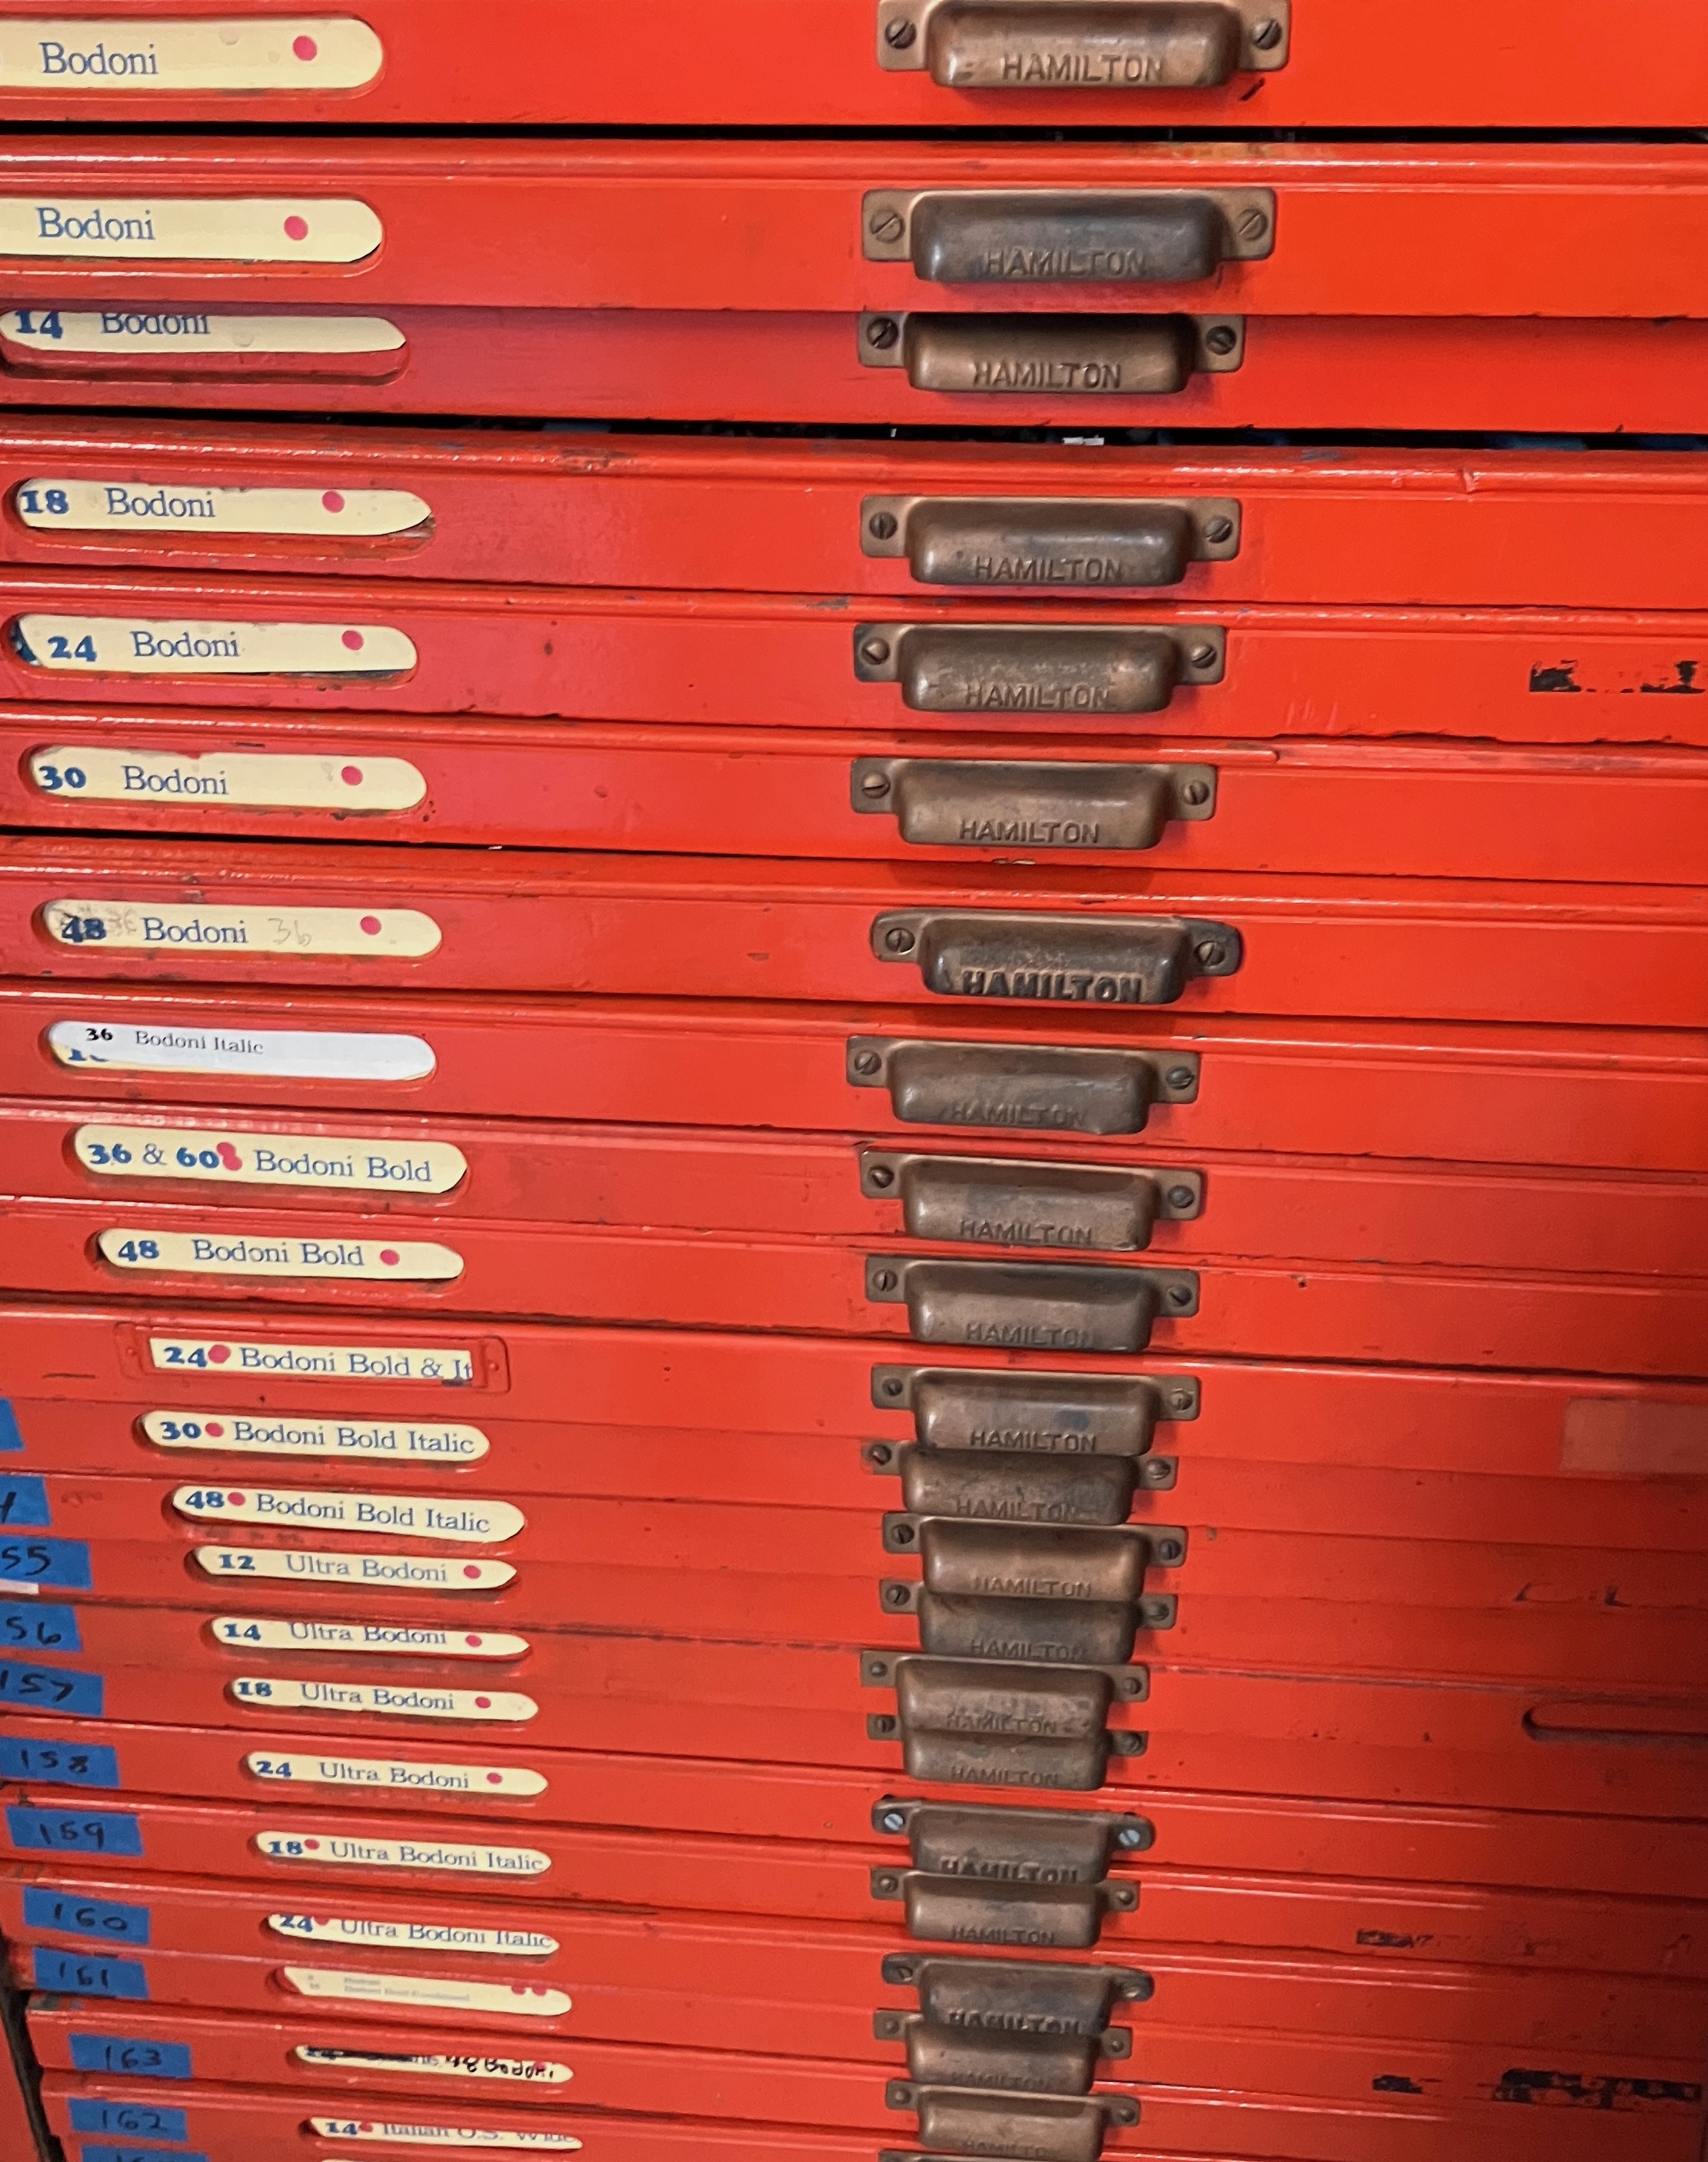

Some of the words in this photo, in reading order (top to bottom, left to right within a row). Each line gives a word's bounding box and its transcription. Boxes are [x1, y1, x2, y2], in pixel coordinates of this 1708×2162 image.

[39, 42, 158, 75] Bodoni
[1000, 54, 1163, 82] HAMILTON
[36, 207, 156, 240] Bodoni
[982, 248, 1147, 276] HAMILTON
[15, 311, 63, 339] 14
[972, 361, 1121, 388] HAMILTON
[22, 490, 70, 514] 18
[105, 488, 215, 518] Bodoni
[974, 556, 1124, 582] HAMILTON
[47, 636, 97, 662] 24
[130, 631, 240, 658] Bodoni
[963, 683, 1110, 709] HAMILTON
[38, 767, 87, 791] 30
[123, 765, 228, 795] Bodoni
[959, 820, 1100, 844] HAMILTON
[60, 915, 107, 943] 48
[142, 916, 248, 944] Bodoni
[962, 971, 1141, 1001] HAMILTON
[85, 1028, 113, 1041] 36
[136, 1031, 205, 1049] Bodoni
[215, 1036, 264, 1054] Italic
[952, 1101, 1086, 1128] HAMILTON
[87, 1143, 132, 1164] 36
[142, 1144, 167, 1165] &
[177, 1147, 219, 1168] 60
[255, 1150, 354, 1177] Bodoni
[367, 1155, 433, 1182] Bold
[961, 1219, 1092, 1245] HAMILTON
[118, 1240, 160, 1262] 48
[193, 1239, 288, 1264] Bodoni
[301, 1241, 365, 1266] Bold
[966, 1322, 1094, 1349] HAMILTON
[163, 1347, 208, 1367] 24
[239, 1348, 337, 1372] Bodoni
[348, 1354, 411, 1376] Bold
[420, 1358, 444, 1378] &
[160, 1421, 201, 1440] 30
[231, 1421, 325, 1446] Bodoni
[337, 1427, 398, 1450] Bold
[408, 1431, 475, 1454] Italic
[969, 1429, 1098, 1453] HAMILTON
[185, 1491, 225, 1508] 48
[256, 1494, 345, 1520] Bodoni
[357, 1502, 414, 1527] Bold
[426, 1509, 490, 1533] Italic
[956, 1499, 1077, 1521] HAMILTON
[218, 1554, 256, 1570] 12
[285, 1554, 351, 1576] Ultra
[362, 1558, 447, 1581] Bodoni
[974, 1577, 1092, 1598] HAMILTON
[224, 1624, 261, 1641] 14
[288, 1622, 353, 1641] Ultra
[363, 1626, 447, 1644] Bodoni
[971, 1638, 1087, 1661] HAMILTON
[237, 1681, 273, 1697] 18
[300, 1683, 362, 1704] Ultra
[372, 1689, 454, 1710] Bodoni
[946, 1708, 1057, 1733] HAMILTON
[21, 1749, 89, 1774] 158
[255, 1761, 292, 1777] 24
[319, 1762, 379, 1782] Ultra
[389, 1768, 469, 1789] Bodoni
[951, 1766, 1059, 1787] HAMILTON
[39, 1821, 104, 1849] 159
[268, 1840, 303, 1855] 18
[329, 1841, 389, 1861] Ultra
[398, 1846, 478, 1867] Bodoni
[486, 1851, 544, 1871] Italic
[940, 1856, 1077, 1883] HAMILTON
[54, 1904, 127, 1930] 160
[280, 1914, 314, 1933] 24
[340, 1920, 398, 1938] Ultra
[408, 1924, 486, 1944] Bodoni
[495, 1930, 553, 1948] Italic
[952, 1925, 1056, 1945] HAMILTON
[59, 1962, 108, 1989] 161
[105, 2046, 161, 2070] 163
[102, 2110, 169, 2130] 162
[326, 2122, 358, 2135] 14
